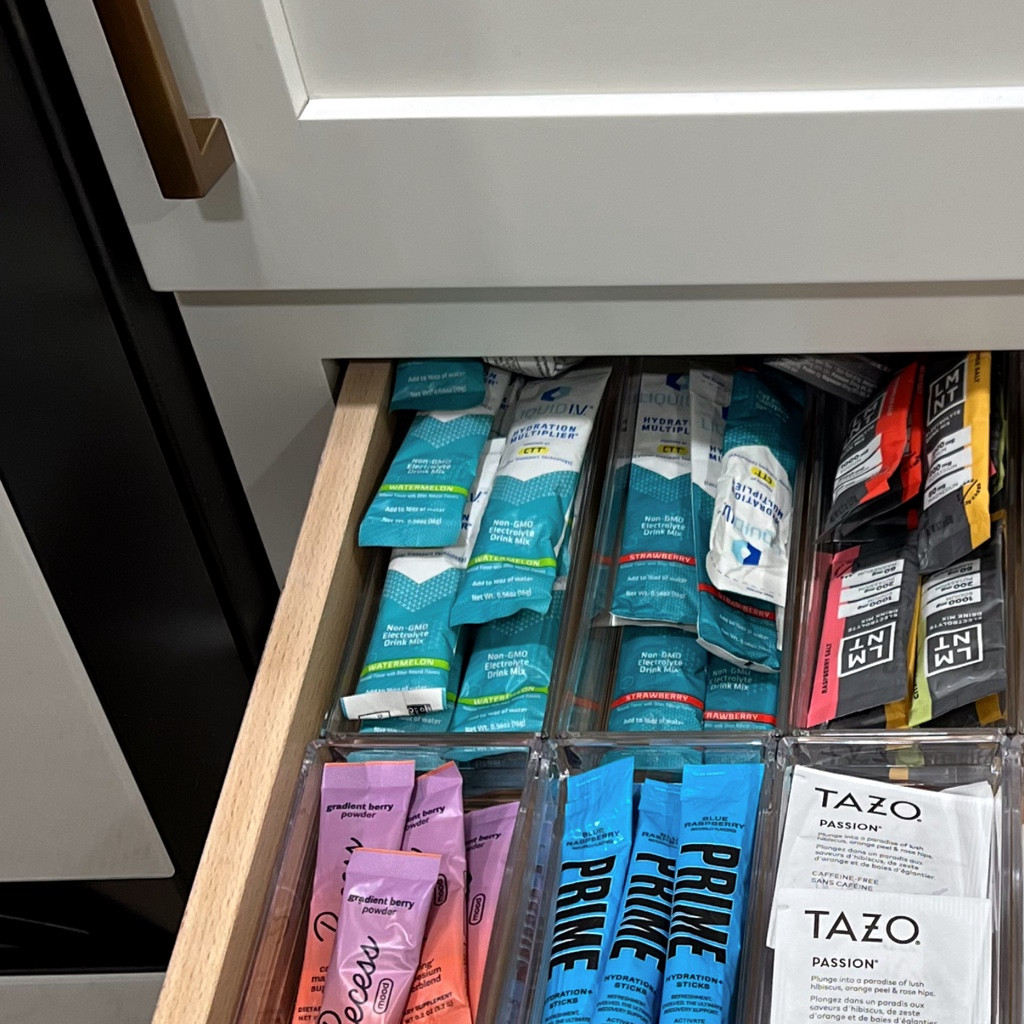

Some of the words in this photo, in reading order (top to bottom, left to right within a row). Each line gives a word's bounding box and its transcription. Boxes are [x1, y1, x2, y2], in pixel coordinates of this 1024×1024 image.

[513, 423, 576, 437] HYDRATION
[511, 430, 575, 444] MULTIPLIER
[493, 520, 533, 528] Non-GMO
[489, 527, 535, 537] Electrolyte
[490, 534, 512, 543] Drink
[630, 553, 690, 563] STRAWBERRY
[368, 660, 434, 671] WATERMELON
[822, 655, 831, 694] RASPBERRY
[626, 692, 689, 702] STRAWBERRY
[326, 802, 366, 812] gradient
[369, 803, 393, 811] berry
[815, 787, 921, 820] TAZO
[341, 811, 376, 819] powder
[684, 821, 745, 830] RASPBERRY
[820, 820, 878, 832] PASSION
[348, 894, 388, 905] gradient
[390, 897, 415, 909] berry
[667, 842, 741, 965] PRIME
[362, 906, 396, 916] powder
[609, 852, 676, 974] PRIME
[549, 855, 616, 980] PRIME
[805, 910, 919, 945] TAZO
[812, 957, 874, 969] PASSION
[676, 981, 710, 989] STICKS
[864, 978, 896, 986] paradise
[908, 980, 924, 988] lush
[377, 982, 390, 1009] mood
[810, 984, 843, 992] hibiscus,
[918, 989, 936, 997] hips.
[810, 996, 842, 1004] Plongez
[878, 1000, 908, 1008] paradis
[843, 1005, 884, 1015] d'hibiscus,
[809, 1013, 845, 1021] d'orange
